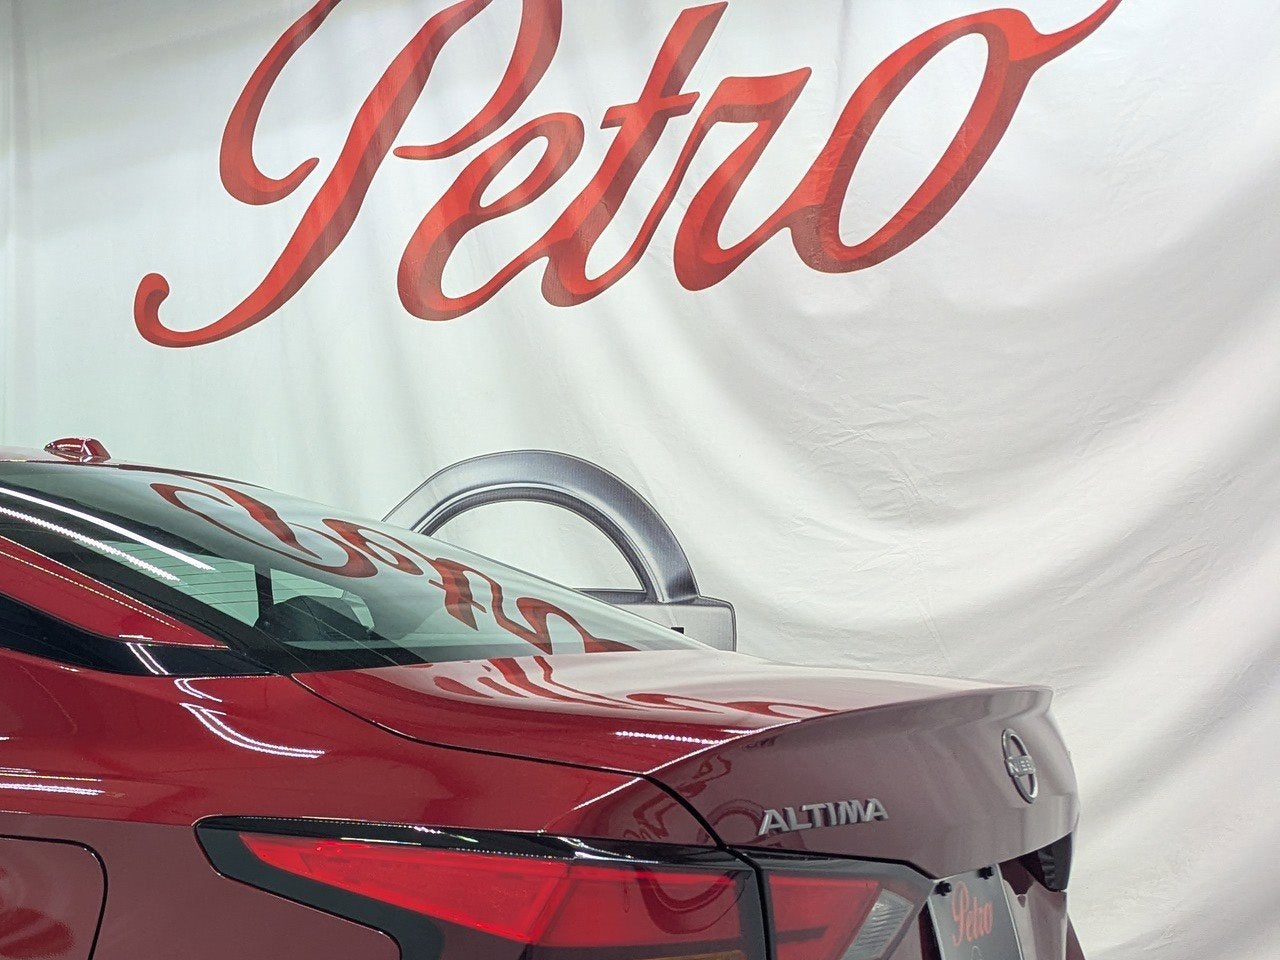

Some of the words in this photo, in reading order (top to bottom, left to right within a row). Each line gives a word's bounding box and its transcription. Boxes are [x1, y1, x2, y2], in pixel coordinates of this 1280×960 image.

[133, 0, 1116, 348] Petro
[758, 798, 889, 836] ALTIMA
[950, 880, 994, 947] Petro
